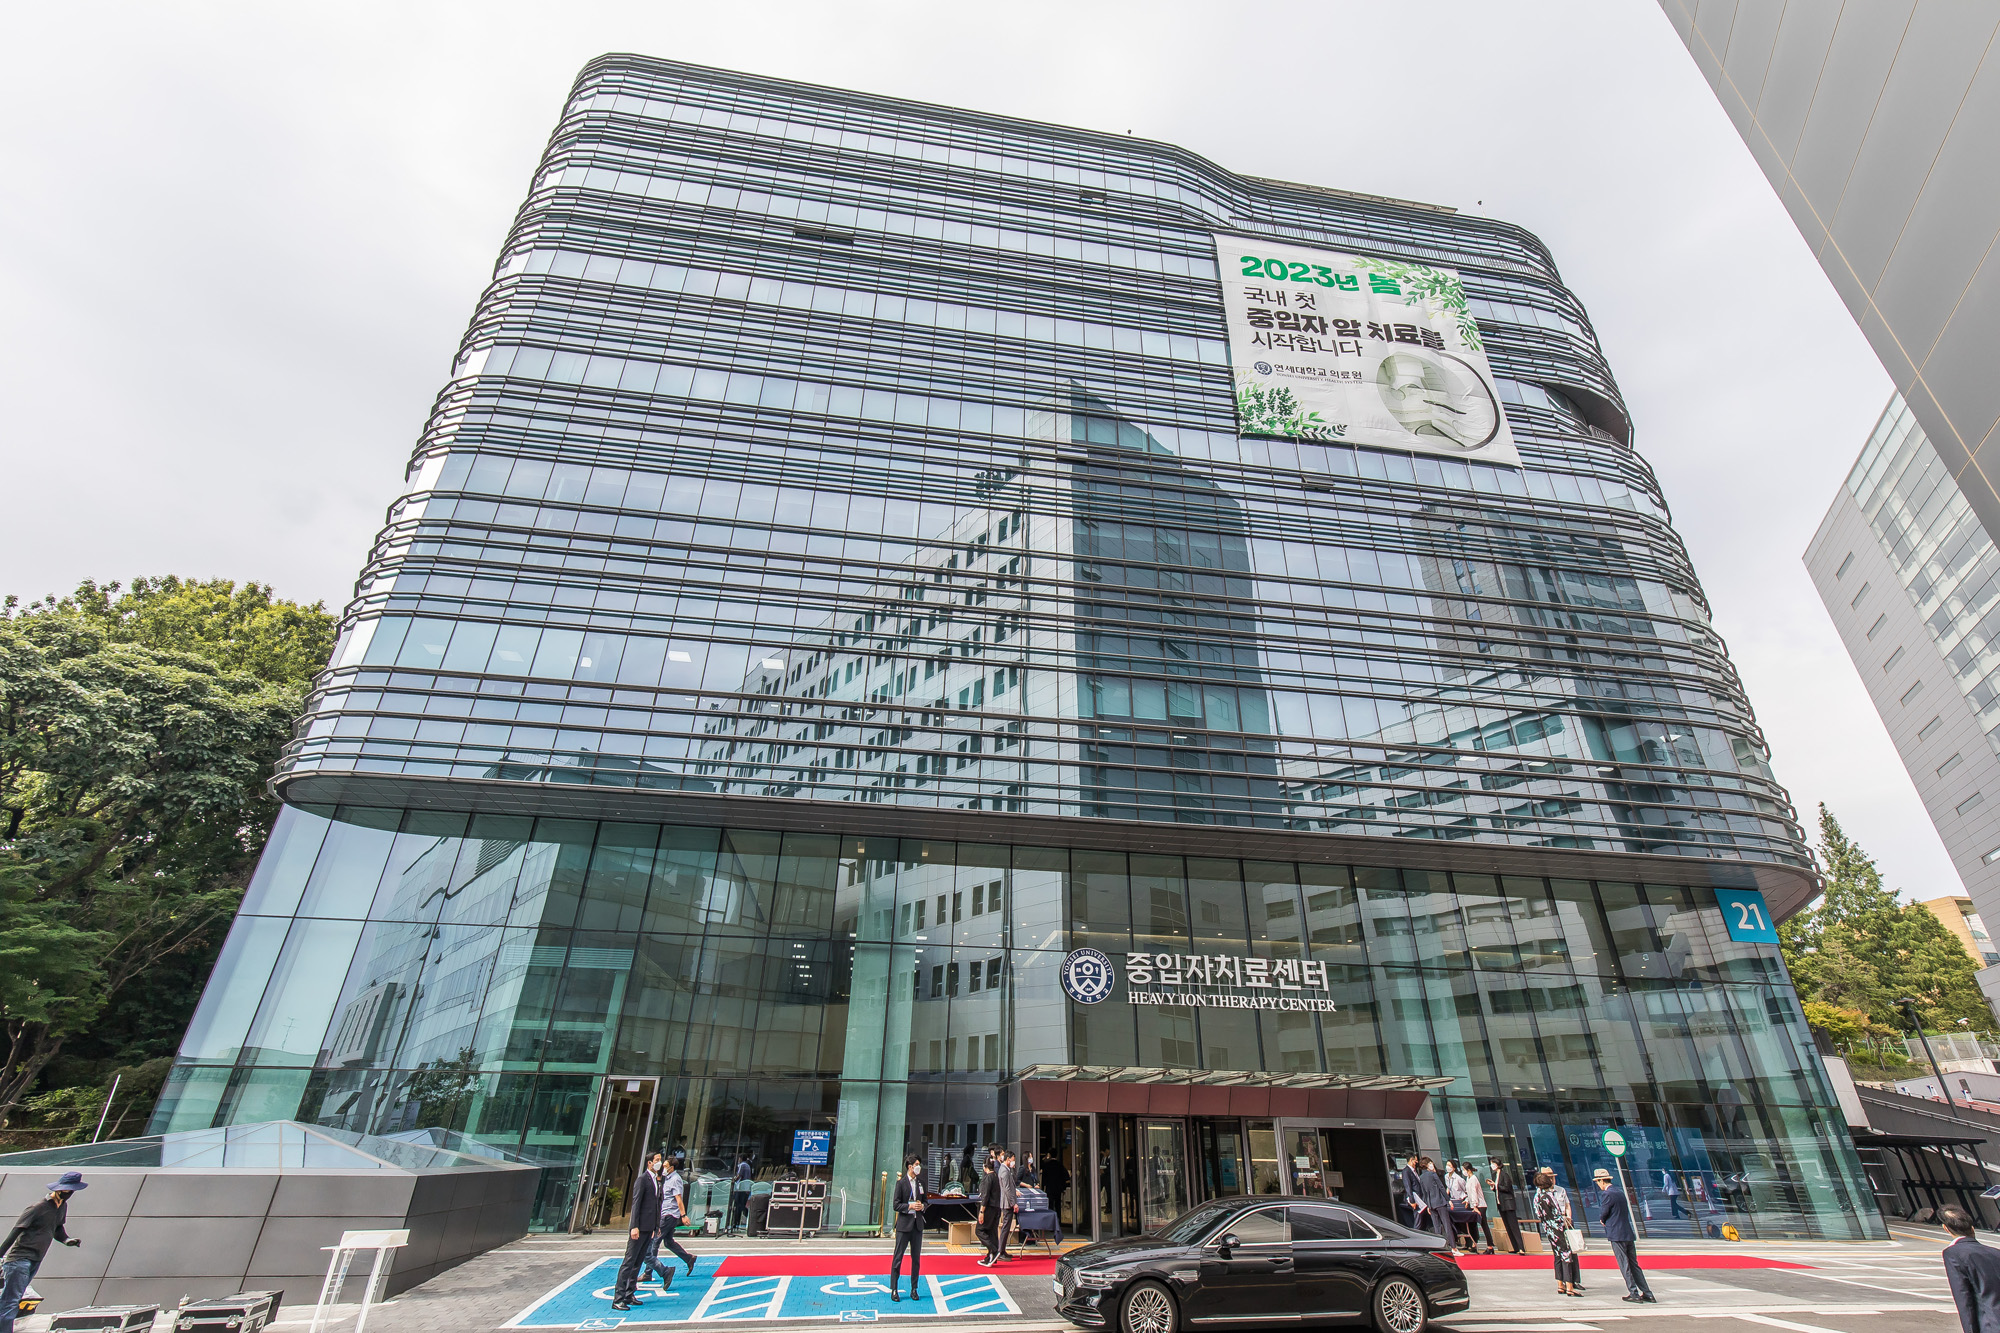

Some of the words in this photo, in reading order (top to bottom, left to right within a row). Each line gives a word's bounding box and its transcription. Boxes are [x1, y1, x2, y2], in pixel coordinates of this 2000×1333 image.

[1240, 256, 1360, 292] 2023년
[1368, 273, 1402, 296] 봄
[1243, 286, 1287, 307] 국내
[1295, 291, 1316, 311] 첫
[1247, 307, 1329, 336] 중입자
[1332, 318, 1362, 338] 암
[1367, 320, 1446, 351] 치료를
[1251, 331, 1363, 357] 시작합니다
[1274, 363, 1327, 377] 연세대학교
[1330, 369, 1363, 380] 의료원
[1731, 902, 1766, 930] 21
[1063, 952, 1080, 976] YONSEI
[1080, 949, 1112, 977] UNIVERSITY
[1125, 952, 1329, 992] 중입자치료센터
[1128, 991, 1175, 1005] HEAVY
[1180, 993, 1208, 1007] ION
[1209, 994, 1278, 1011] THERAPY
[1279, 998, 1337, 1012] CENTER
[802, 1139, 811, 1151] P
